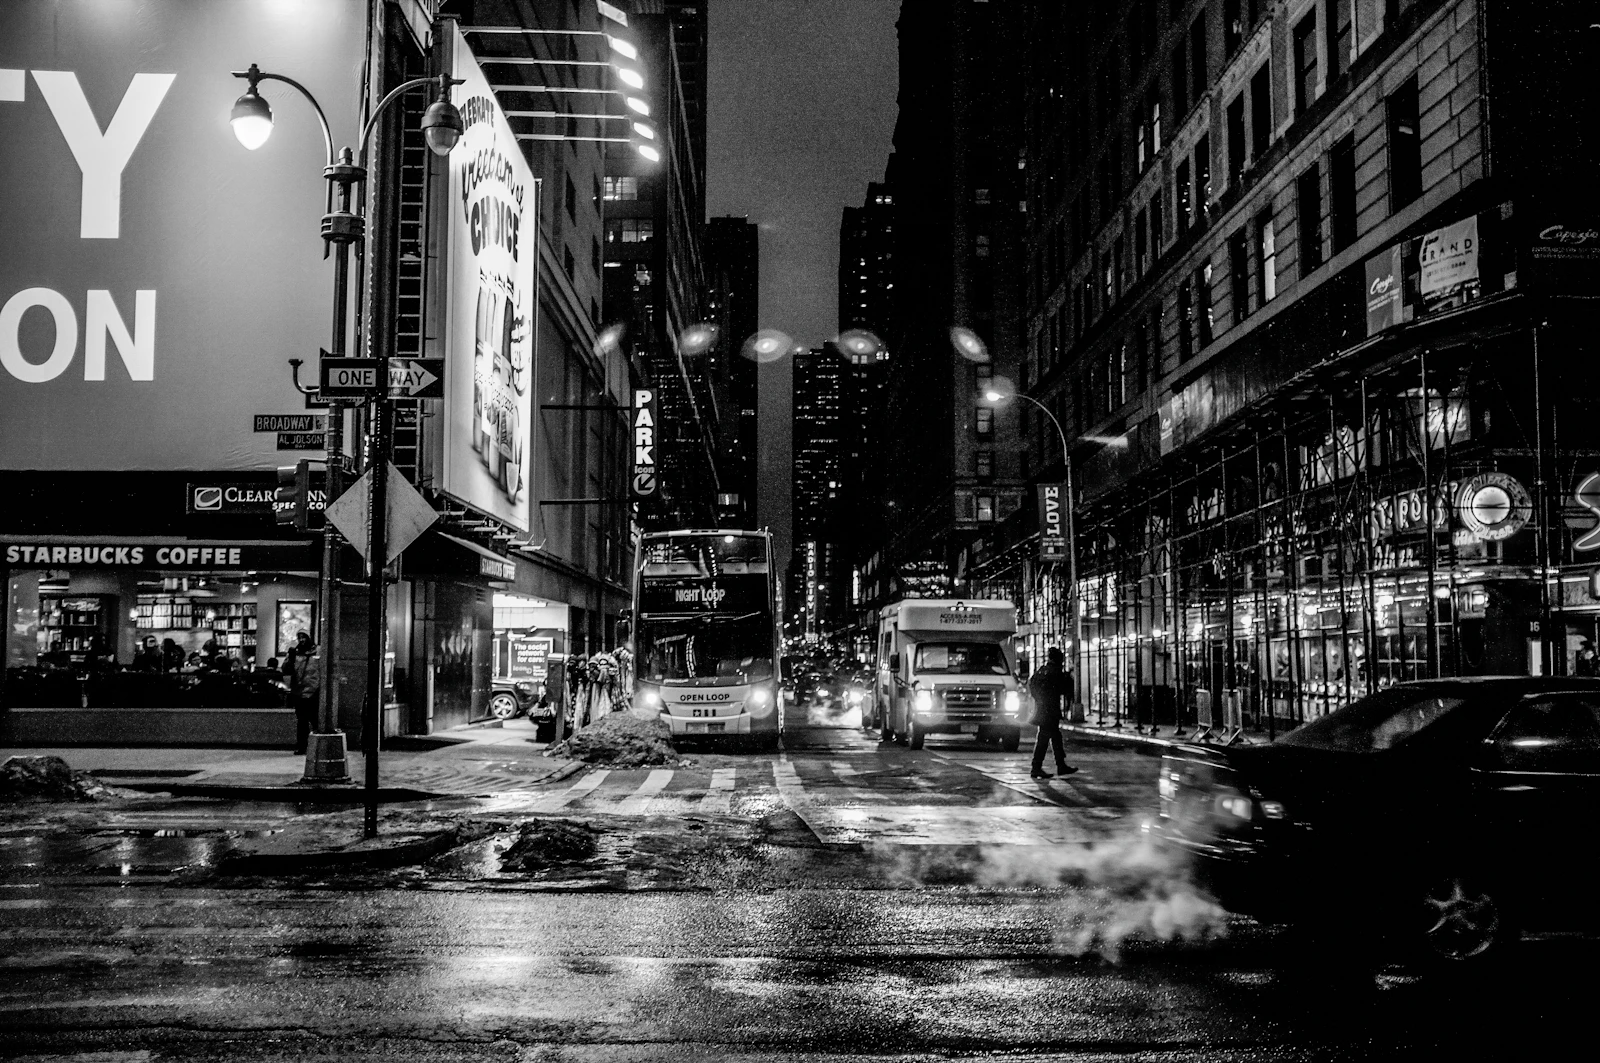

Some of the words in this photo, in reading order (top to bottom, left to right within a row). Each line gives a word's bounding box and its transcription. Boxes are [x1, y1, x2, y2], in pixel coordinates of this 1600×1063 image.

[459, 95, 494, 131] ELEBRATE
[0, 69, 177, 239] Y
[470, 195, 519, 263] CHOICE
[0, 286, 157, 384] ON
[338, 370, 373, 386] ONE
[389, 370, 426, 387] WAY
[256, 416, 310, 430] BROADWAY
[635, 390, 654, 465] PARK
[278, 434, 289, 445] AL
[290, 434, 323, 445] JOLSON
[634, 465, 655, 474] icon
[1045, 486, 1060, 535] LOVE
[6, 546, 144, 565] STARBUCKS
[156, 546, 241, 565] COFFEE
[807, 541, 815, 577] RADIO
[675, 588, 700, 602] NIGHT
[702, 588, 726, 602] LOOP
[807, 580, 815, 609] CITY
[514, 643, 527, 651] The
[528, 643, 548, 651] social
[680, 694, 704, 702] OPEN
[706, 693, 730, 701] LOOP
